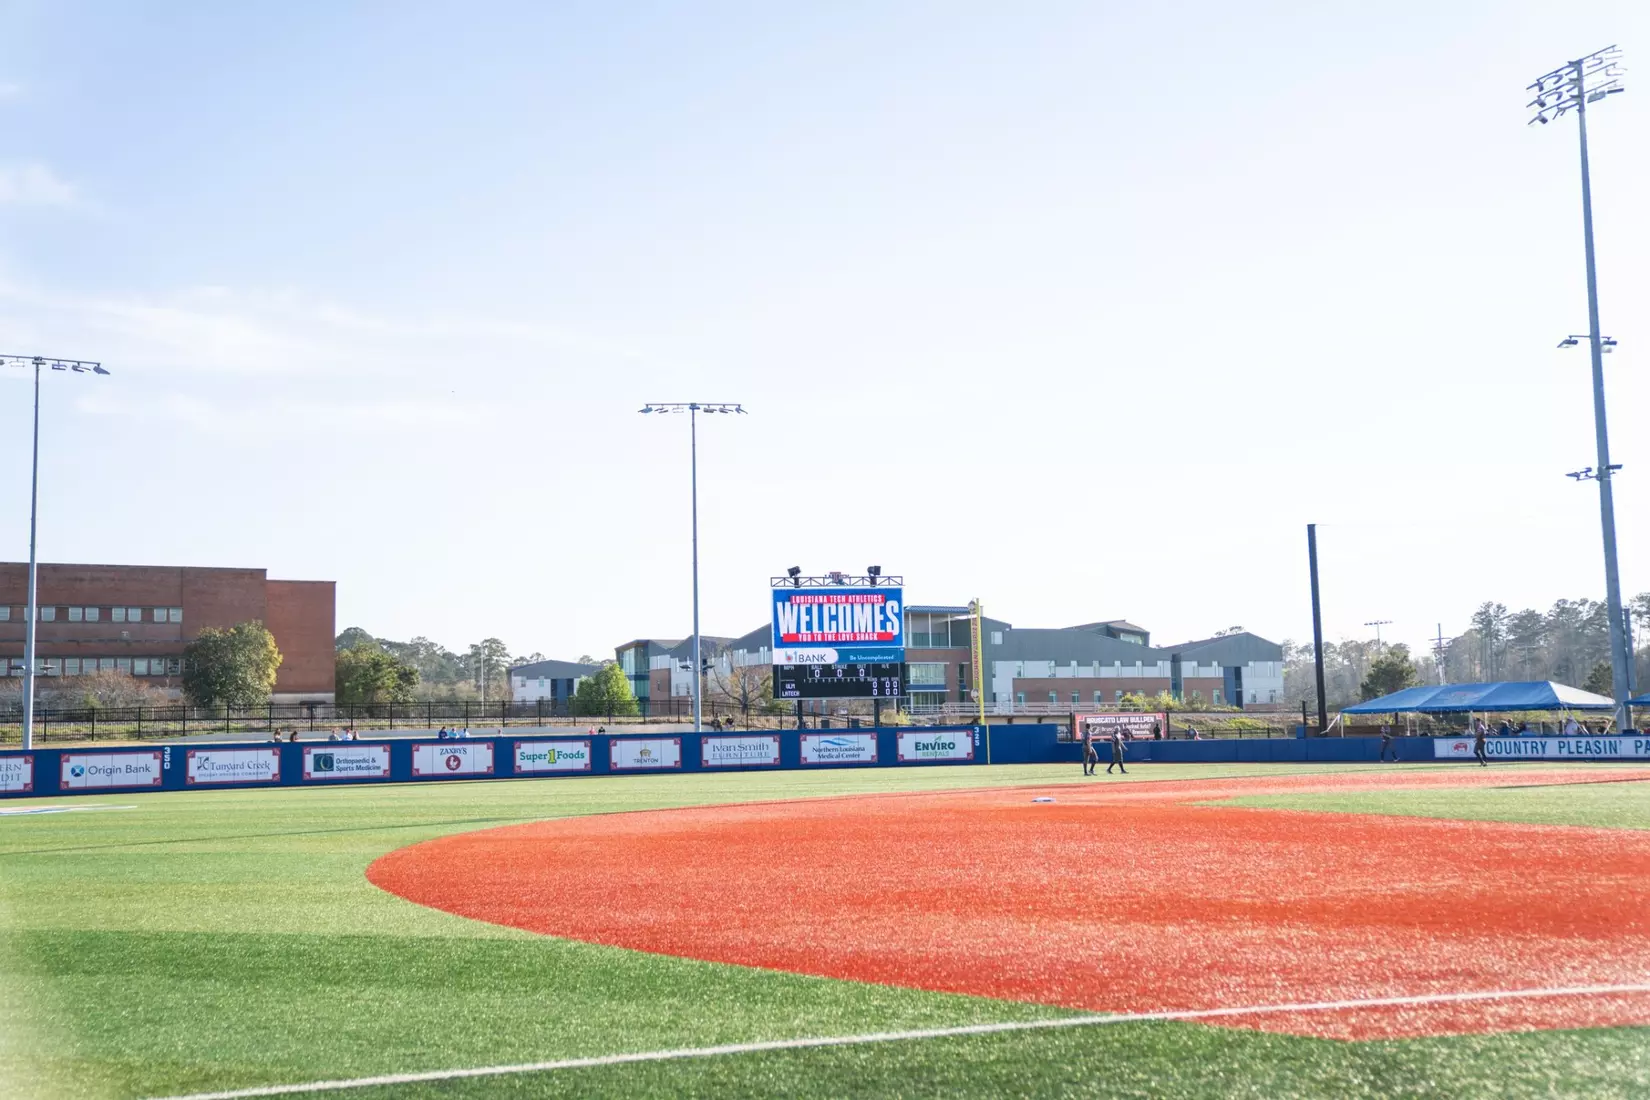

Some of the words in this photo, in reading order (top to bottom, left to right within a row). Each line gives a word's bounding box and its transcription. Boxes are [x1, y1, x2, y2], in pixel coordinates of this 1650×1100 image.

[792, 596, 828, 604] LOUISIANA
[830, 595, 846, 604] TECH
[848, 595, 882, 603] ATHLETICS
[777, 600, 900, 637] WELCOMES
[798, 634, 811, 642] YOU
[814, 634, 823, 642] TO
[824, 633, 836, 641] THE
[856, 632, 878, 640] SHACK
[814, 669, 820, 678] 0
[837, 669, 842, 678] 0
[860, 668, 864, 676] 0
[440, 747, 467, 755] ZAXBY'S
[915, 741, 956, 751] ENVIRO
[1486, 740, 1547, 754] COUNTRY
[1558, 740, 1622, 754] PLEASIN'
[520, 752, 547, 762] Super
[548, 748, 557, 764] 1
[557, 750, 584, 759] Foods
[247, 760, 271, 770] Creek
[88, 765, 122, 776] Origin
[126, 765, 151, 774] Bank
